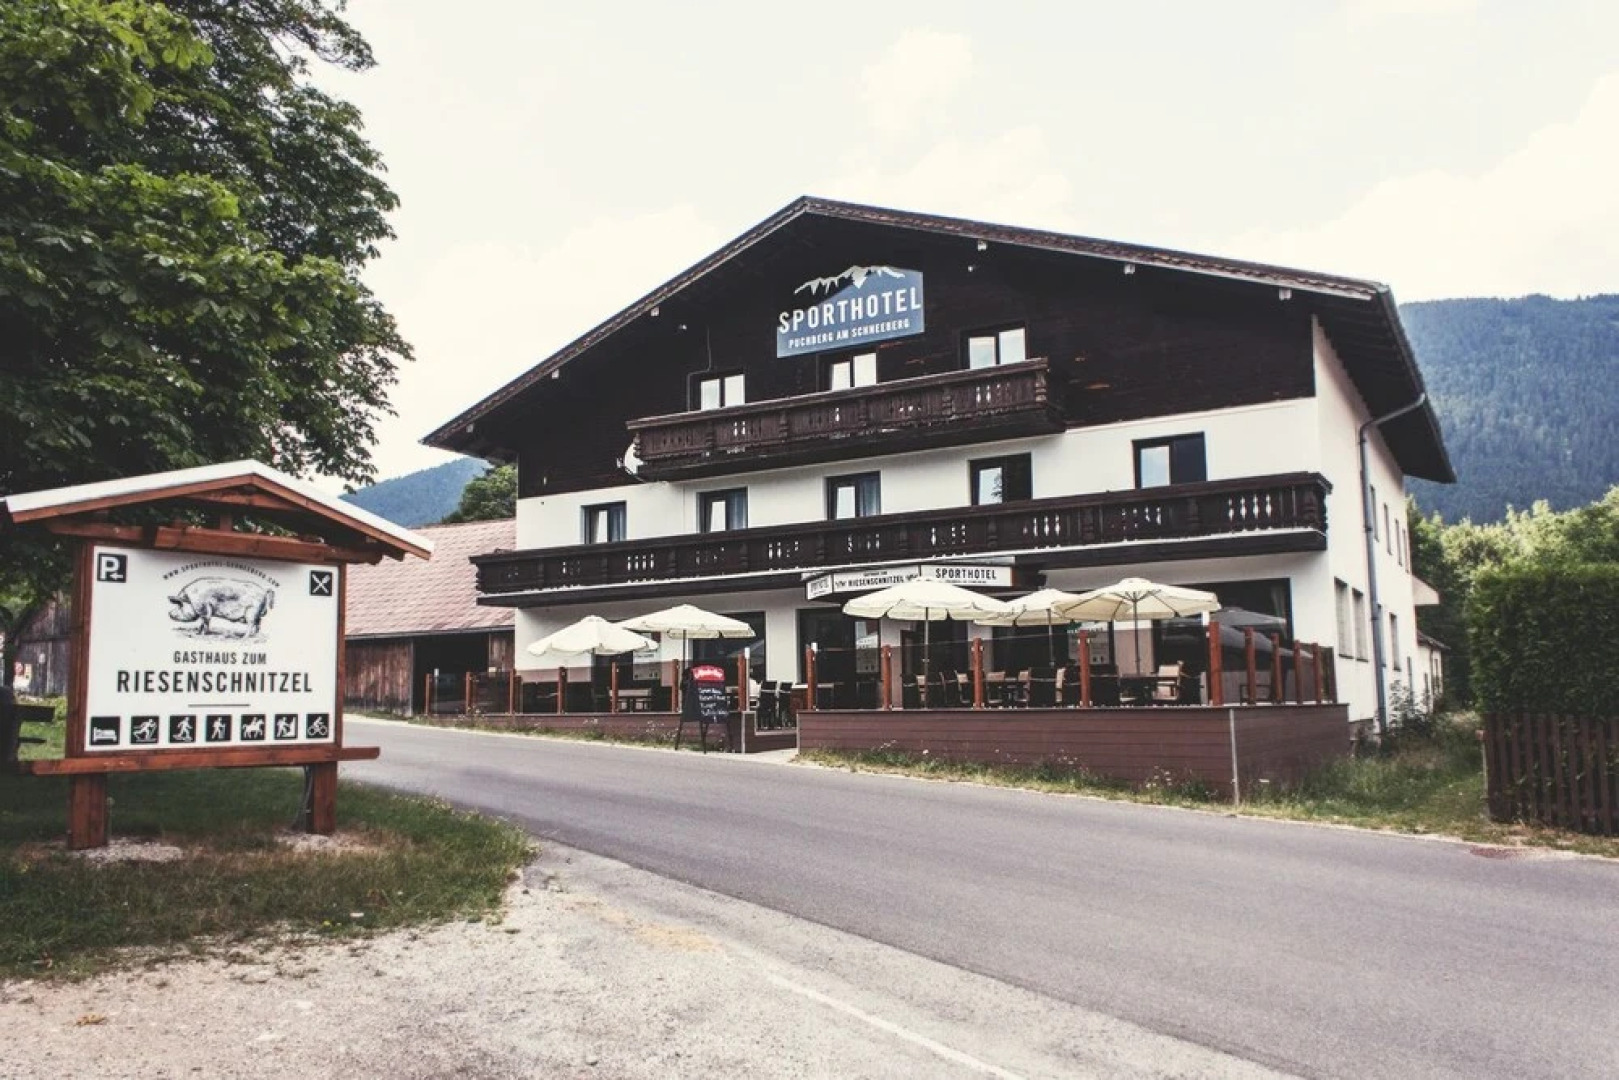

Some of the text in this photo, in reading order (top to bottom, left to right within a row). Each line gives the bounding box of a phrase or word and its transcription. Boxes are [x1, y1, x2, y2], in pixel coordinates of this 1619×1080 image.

[779, 287, 922, 334] SPORTHOTEL
[788, 318, 911, 349] PUCHBERG AM SCHNEEBERG
[935, 567, 997, 580] SPORTHOTEL
[173, 650, 268, 665] GASTHAUS ZUM
[116, 669, 314, 693] RIESENSCHNITZEL
